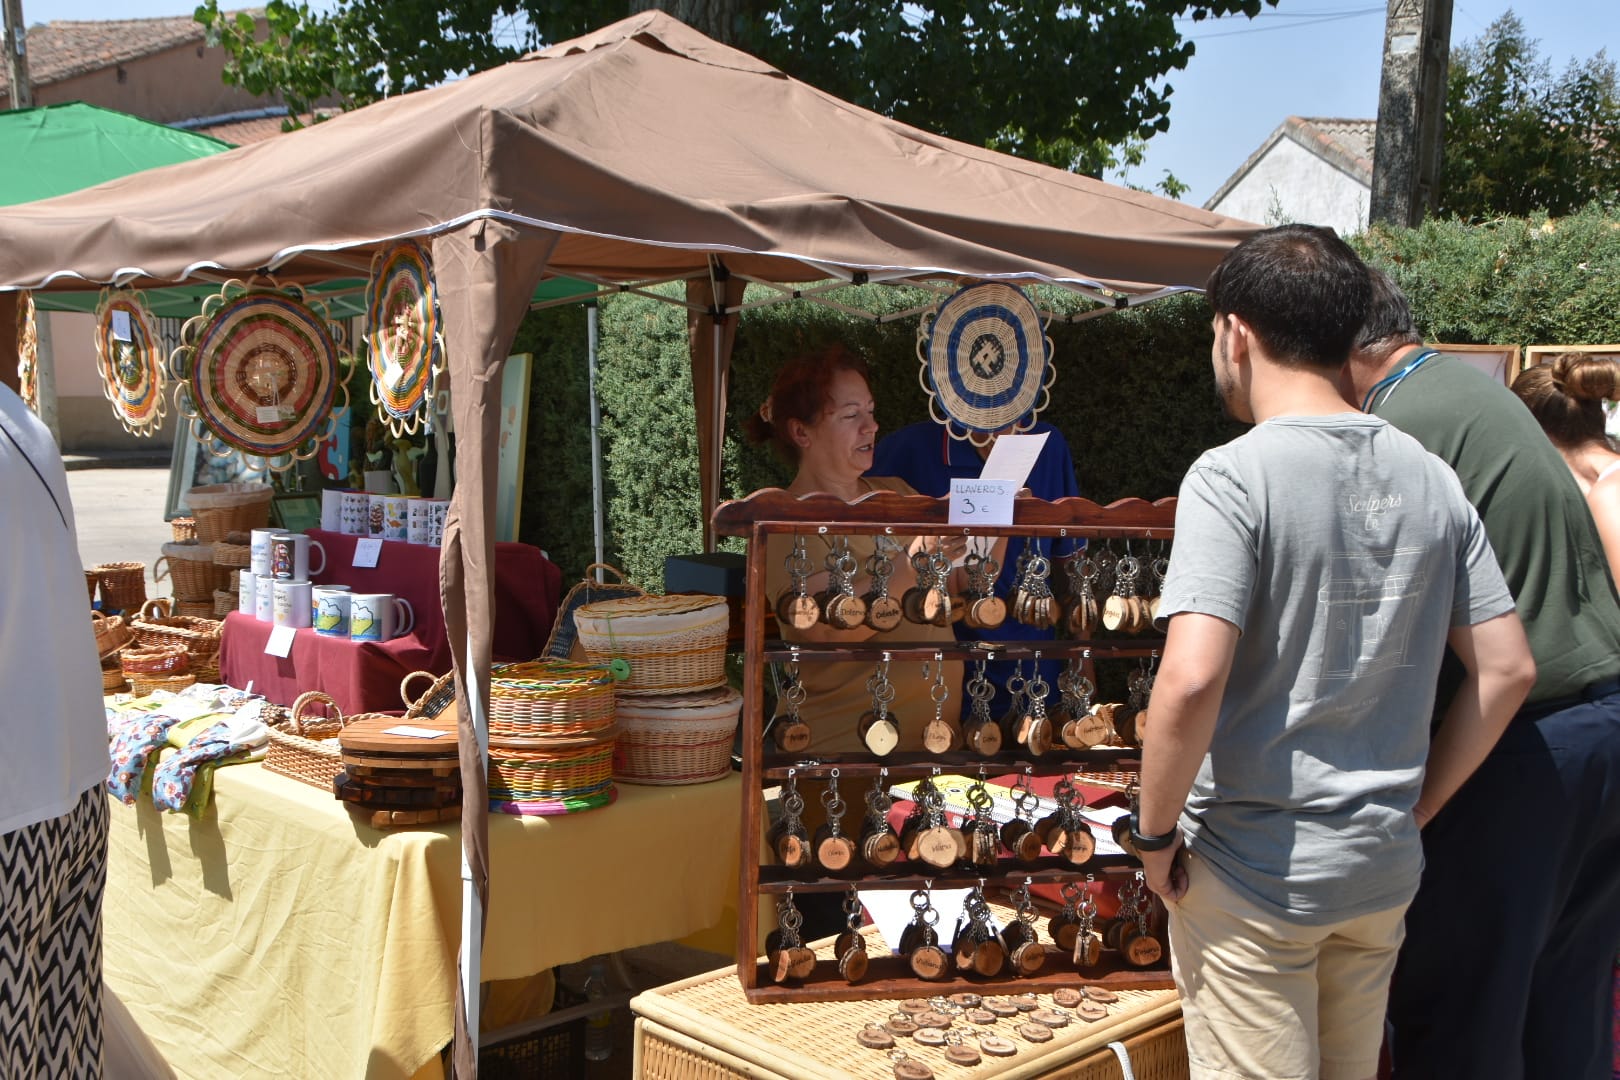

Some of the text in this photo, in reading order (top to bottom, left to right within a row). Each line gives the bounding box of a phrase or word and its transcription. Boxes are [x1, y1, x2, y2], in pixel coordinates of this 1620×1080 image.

[961, 498, 976, 515] 3
[1060, 528, 1067, 536] B
[1145, 528, 1152, 537] A
[987, 651, 995, 660] G
[1035, 650, 1041, 658] F
[1083, 650, 1091, 658] E
[788, 768, 796, 779] P
[831, 767, 840, 778] O
[880, 767, 888, 776] N
[932, 767, 941, 776] M
[1025, 766, 1032, 774] K
[925, 880, 932, 889] V
[979, 878, 987, 887] T
[1024, 876, 1032, 885] S
[1087, 874, 1094, 883] S
[1135, 872, 1144, 881] R
